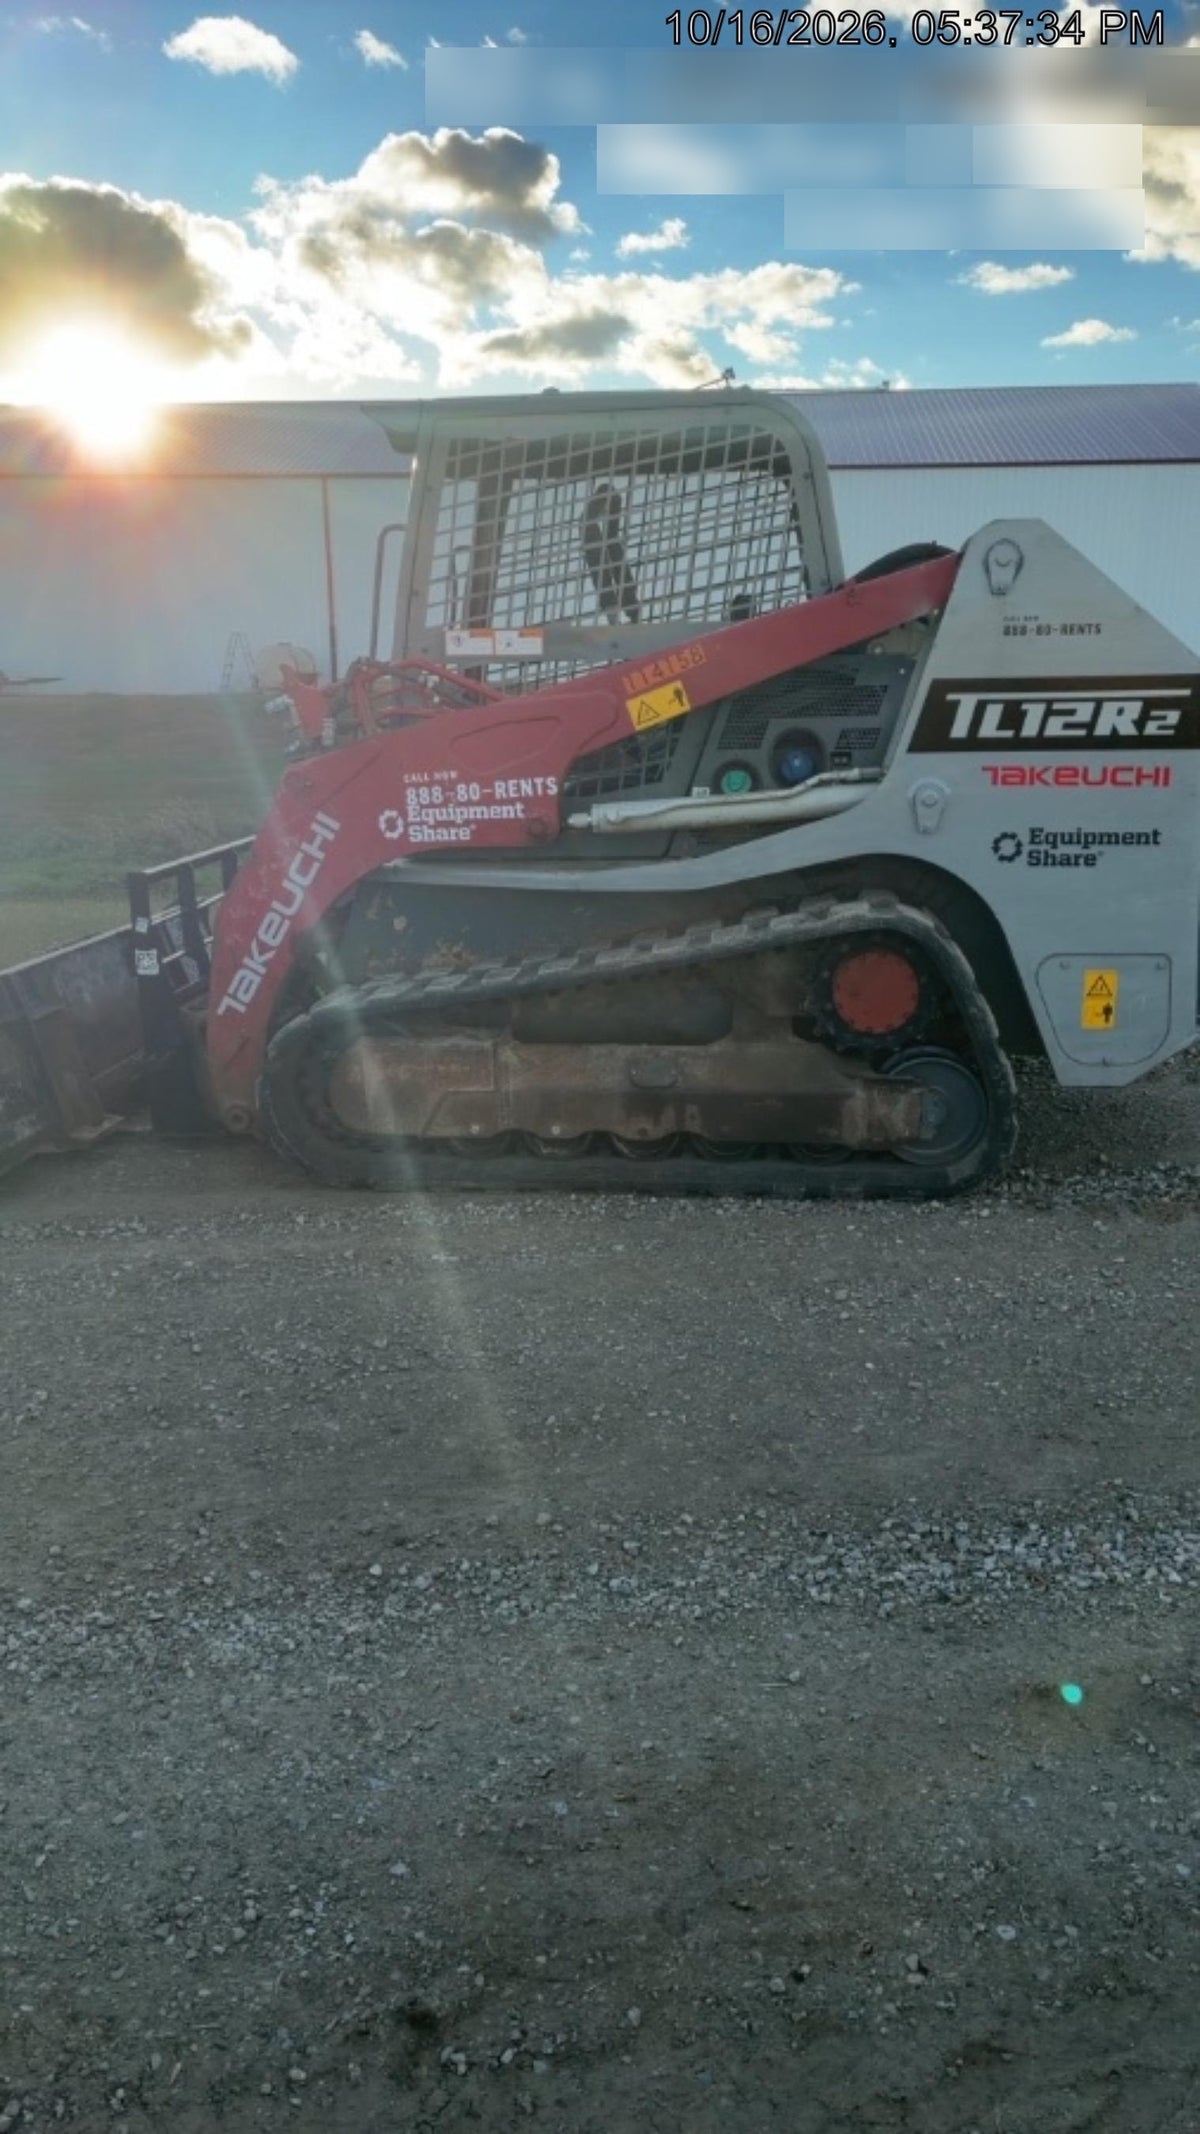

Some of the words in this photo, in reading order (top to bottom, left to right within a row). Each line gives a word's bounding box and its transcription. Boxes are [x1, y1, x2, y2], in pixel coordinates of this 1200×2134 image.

[946, 689, 1191, 738] TL12R2
[406, 777, 558, 805] 888-80-RENTS
[407, 802, 525, 826] Equipment
[408, 824, 471, 843] Share
[1028, 827, 1161, 851] Equipment
[1027, 848, 1098, 867] Share
